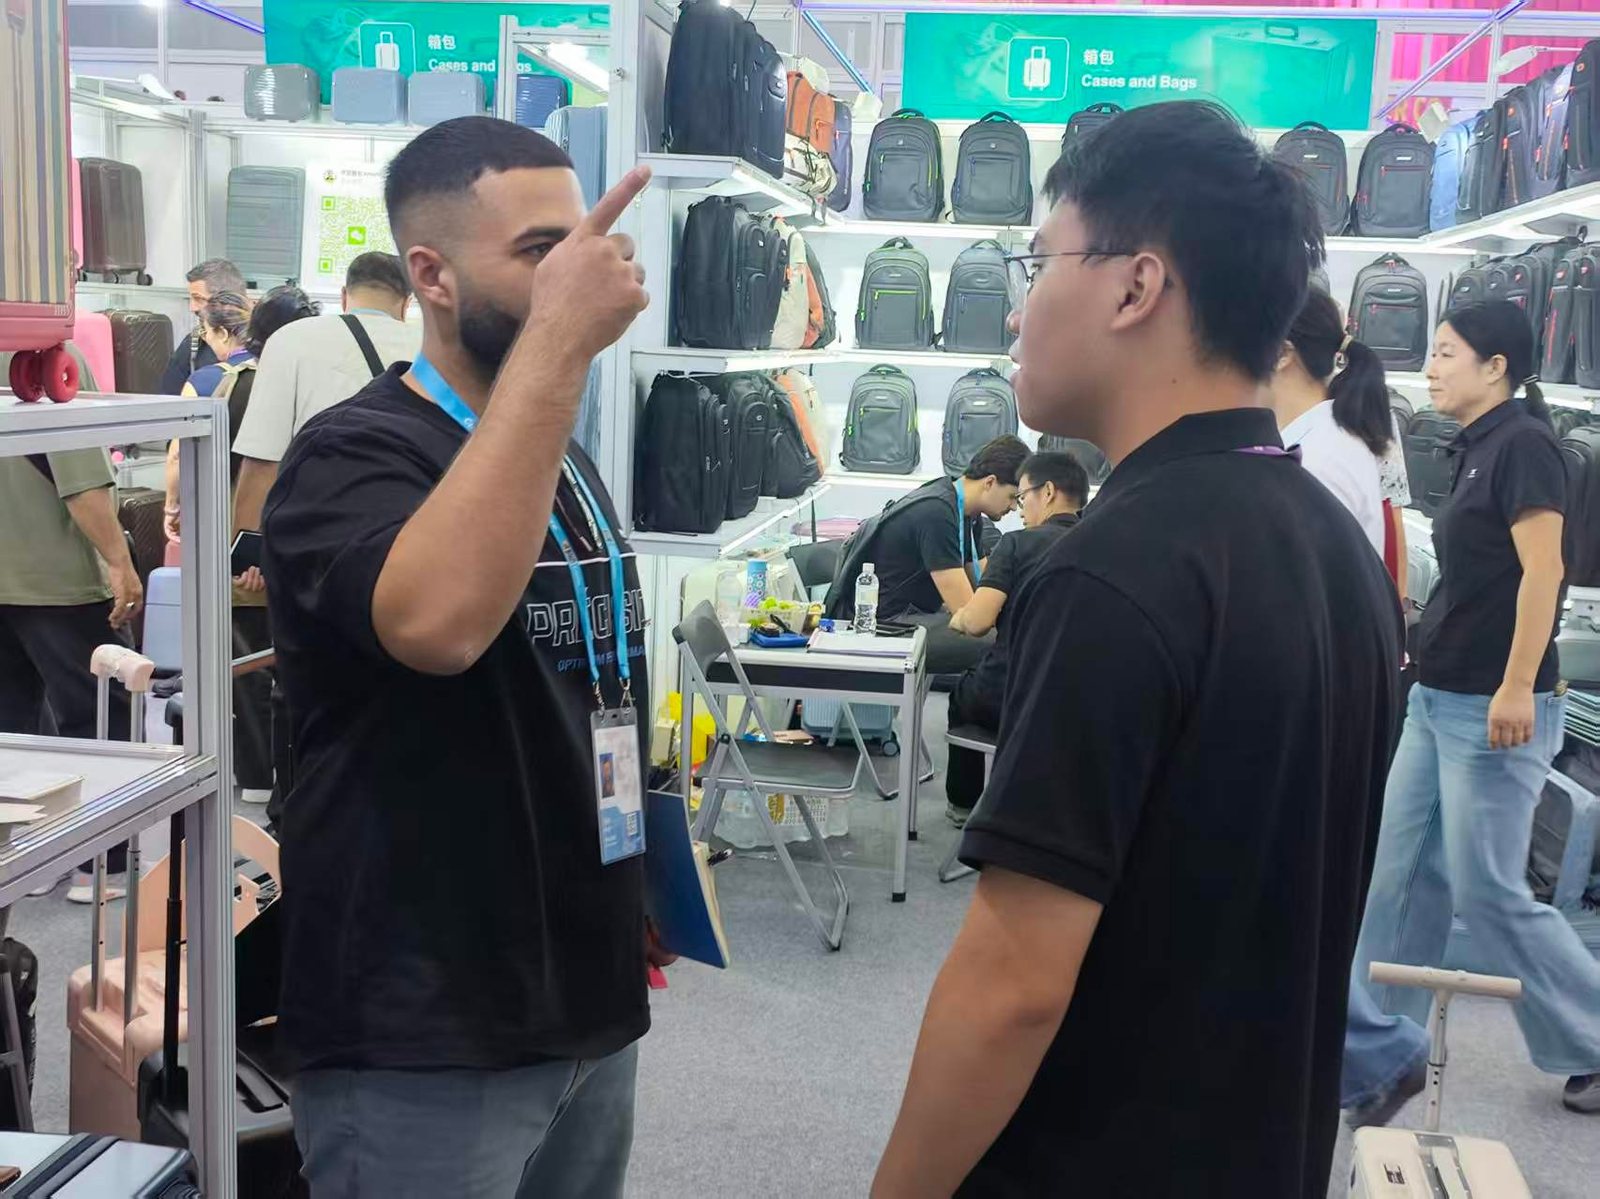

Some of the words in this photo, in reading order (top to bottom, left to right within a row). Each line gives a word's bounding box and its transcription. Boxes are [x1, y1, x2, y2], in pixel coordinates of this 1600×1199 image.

[428, 34, 456, 50] 箱包
[1083, 49, 1115, 65] 箱包
[471, 59, 496, 72] and
[1081, 74, 1126, 88] Cases
[1128, 75, 1157, 89] and
[1160, 75, 1198, 91] Bags
